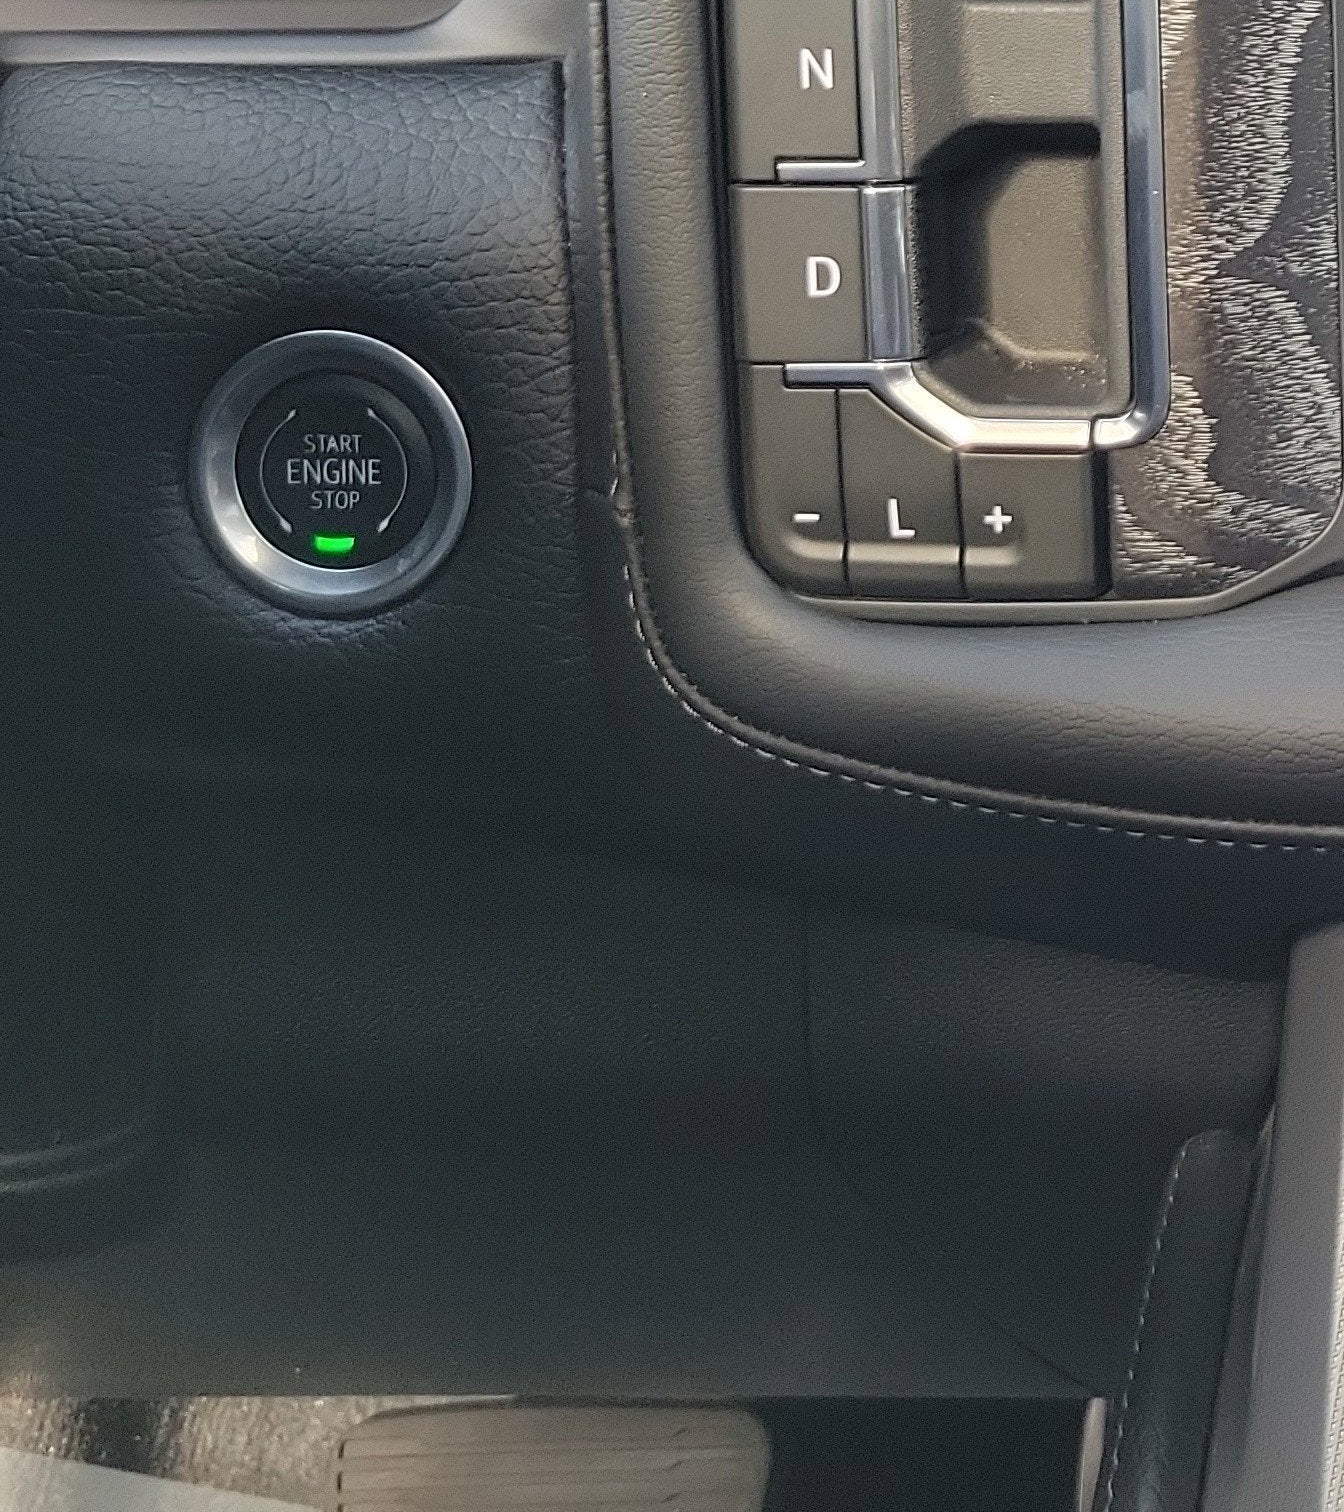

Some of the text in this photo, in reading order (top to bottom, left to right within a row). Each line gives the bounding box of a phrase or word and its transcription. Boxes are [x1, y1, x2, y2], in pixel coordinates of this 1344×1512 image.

[798, 48, 834, 90] N
[805, 257, 842, 296] D
[302, 434, 362, 454] START
[286, 459, 382, 485] ENGINE
[310, 491, 360, 510] STOP
[888, 499, 916, 538] L
